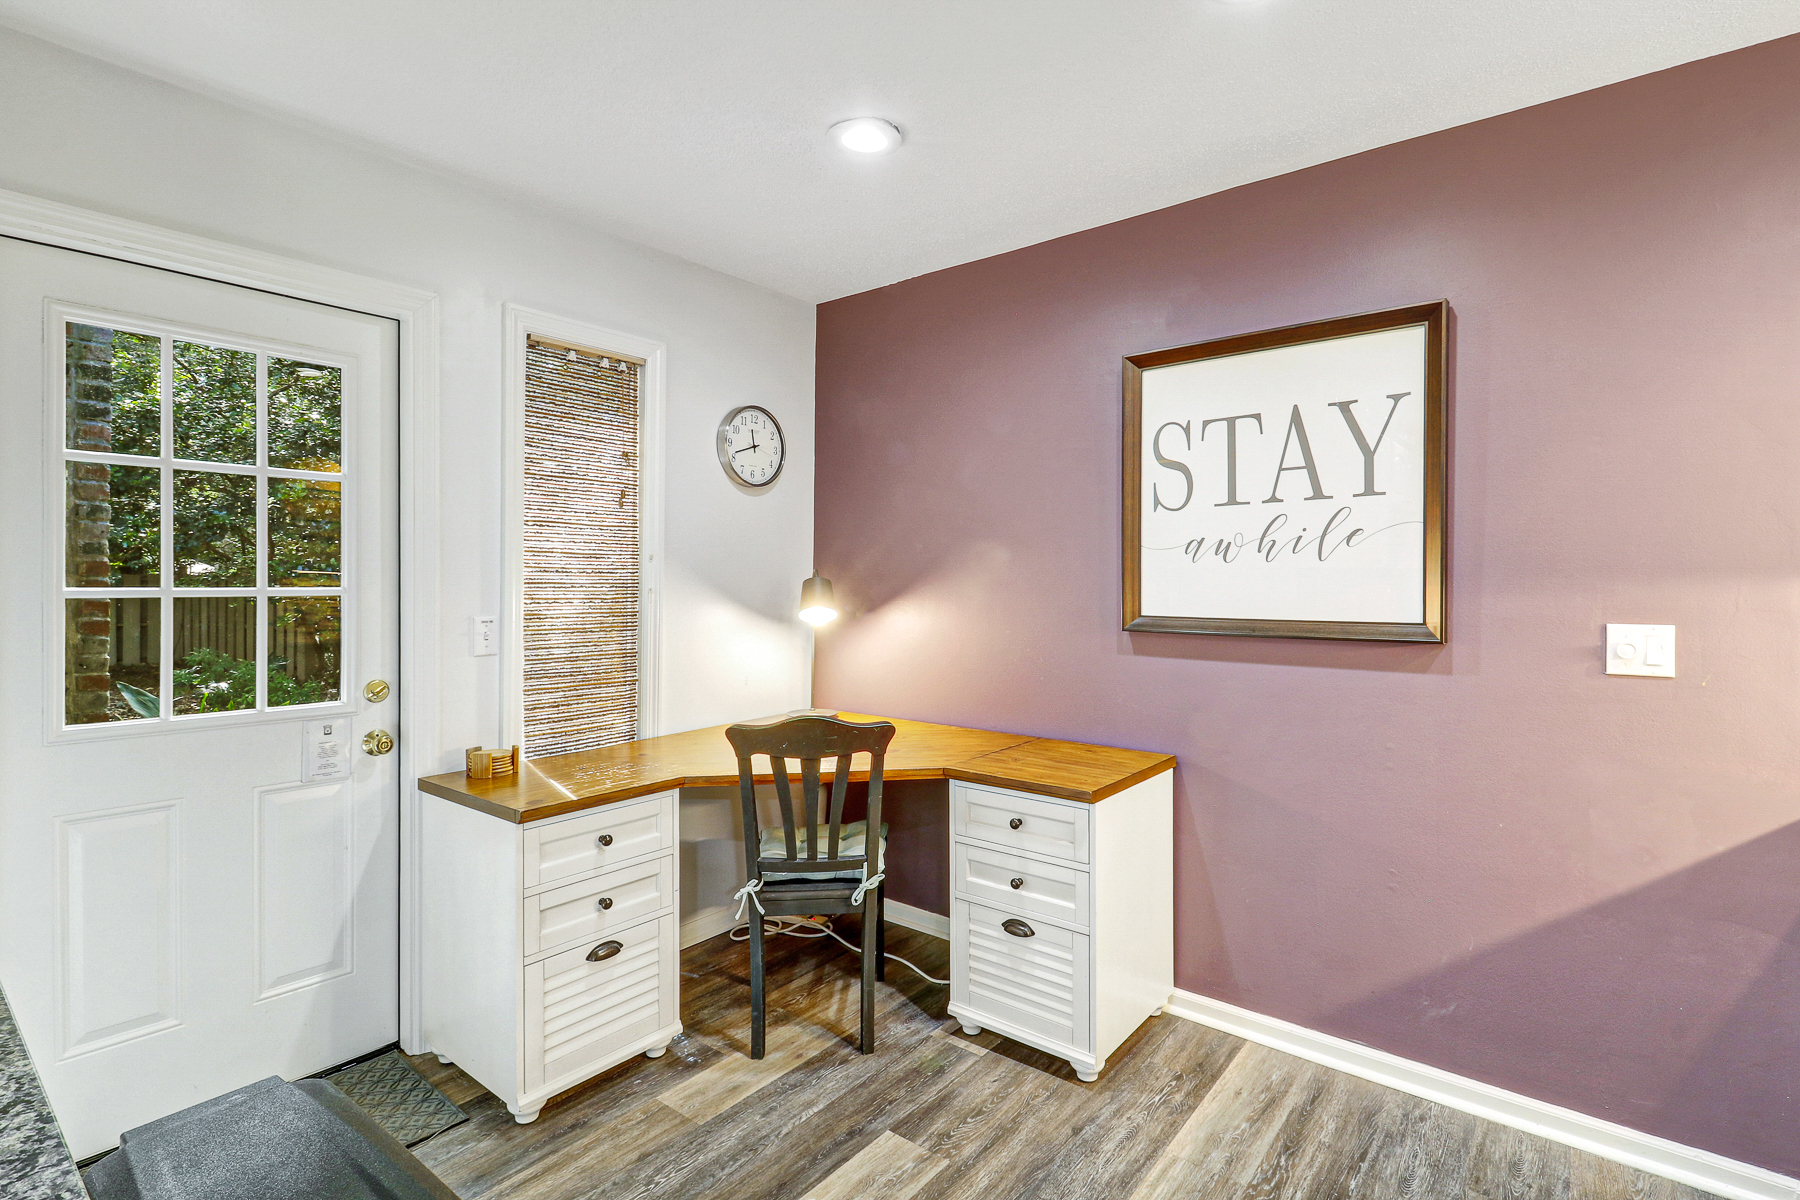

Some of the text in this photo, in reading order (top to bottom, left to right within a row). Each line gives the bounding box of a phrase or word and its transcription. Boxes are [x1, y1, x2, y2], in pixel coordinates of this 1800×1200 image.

[741, 416, 747, 426] 11
[751, 414, 758, 424] 12
[763, 420, 766, 429] 1
[732, 425, 740, 434] 10
[770, 432, 774, 440] 2
[728, 438, 732, 447] 9
[774, 447, 777, 455] 3
[1152, 391, 1411, 512] STAY
[731, 453, 736, 462] 8
[769, 460, 773, 468] 4
[740, 465, 744, 474] 7
[761, 468, 766, 477] 5
[750, 470, 755, 479] 6
[1184, 506, 1365, 564] awhile
